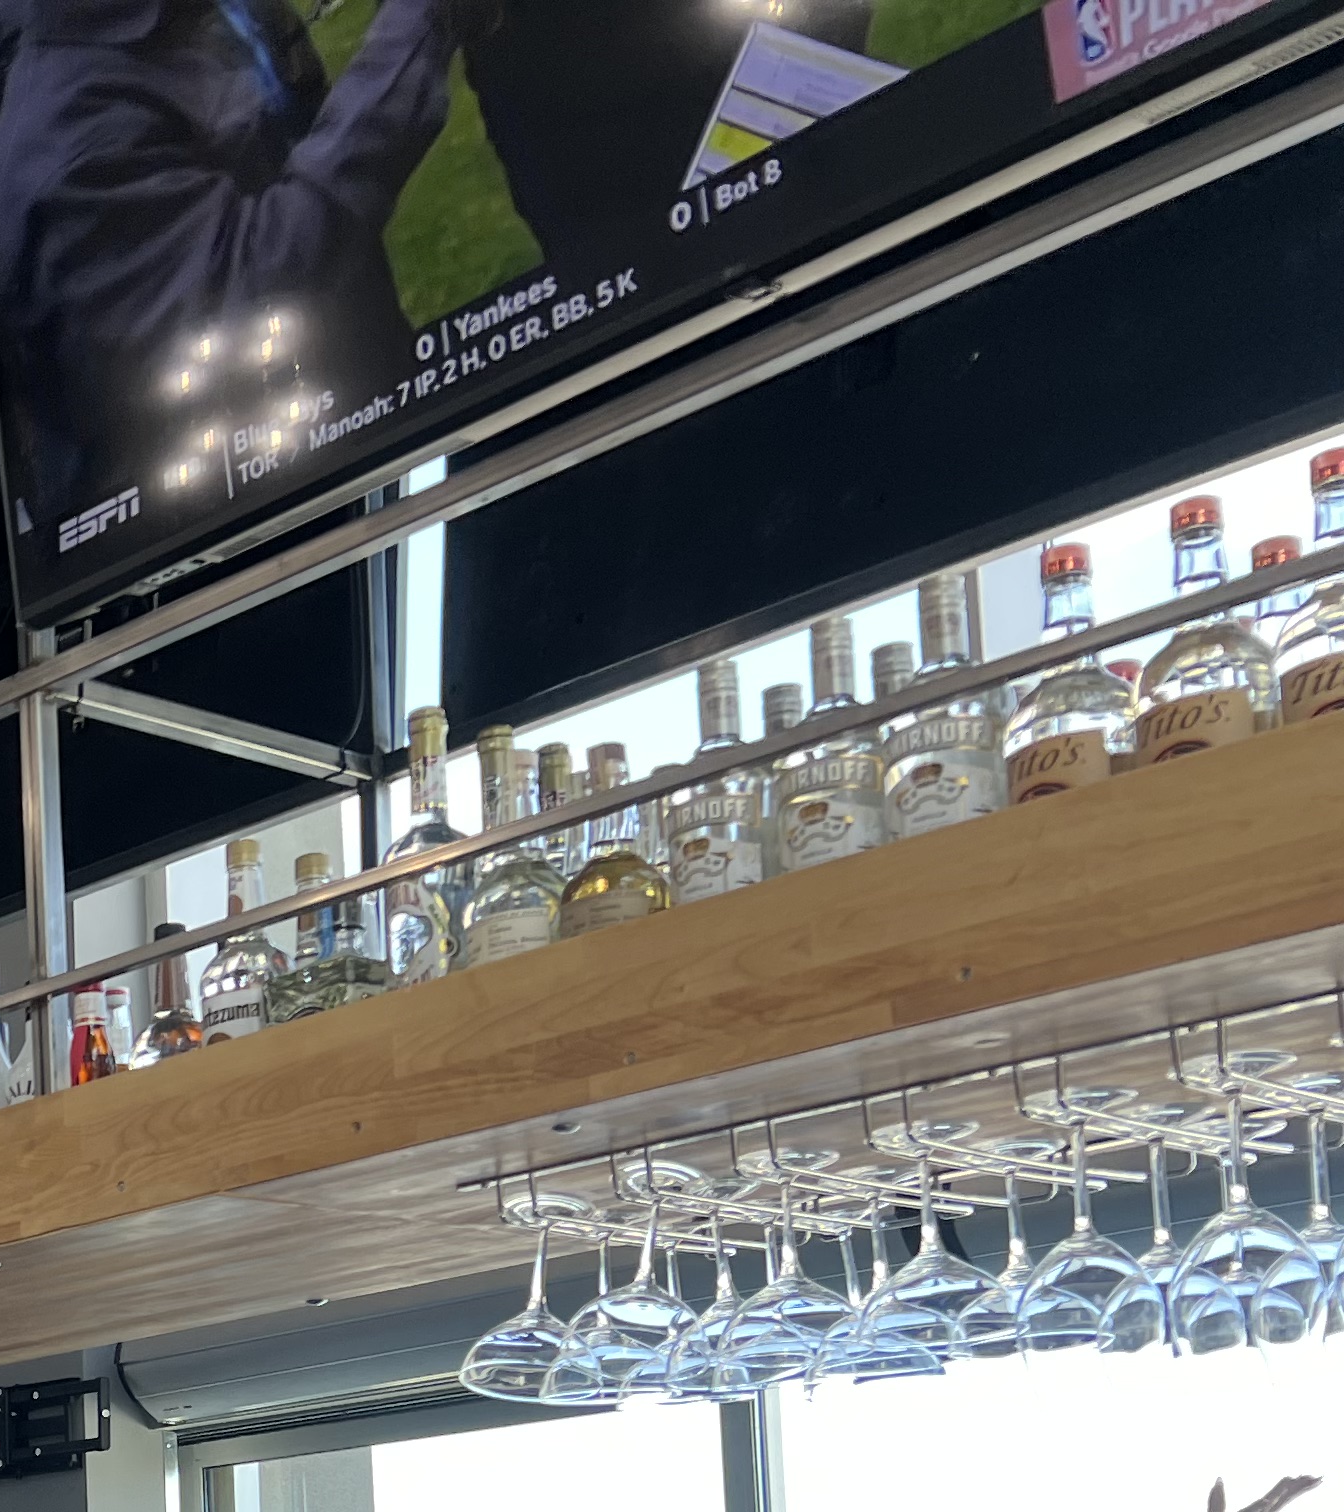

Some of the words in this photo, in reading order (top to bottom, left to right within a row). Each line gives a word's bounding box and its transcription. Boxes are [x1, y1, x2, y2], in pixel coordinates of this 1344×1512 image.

[715, 171, 759, 212] Bot
[454, 275, 557, 341] Yankees
[238, 452, 279, 484] TOR
[310, 394, 395, 451] Manoah:
[396, 382, 410, 408] 7
[443, 360, 458, 386] 2
[596, 281, 614, 308] 5
[615, 268, 638, 297] K
[59, 486, 140, 553] ESPN
[1292, 659, 1344, 706] Tit
[791, 761, 870, 791] IRNOFF
[675, 800, 747, 828] IRNOFF
[205, 1003, 260, 1028] tezuma
